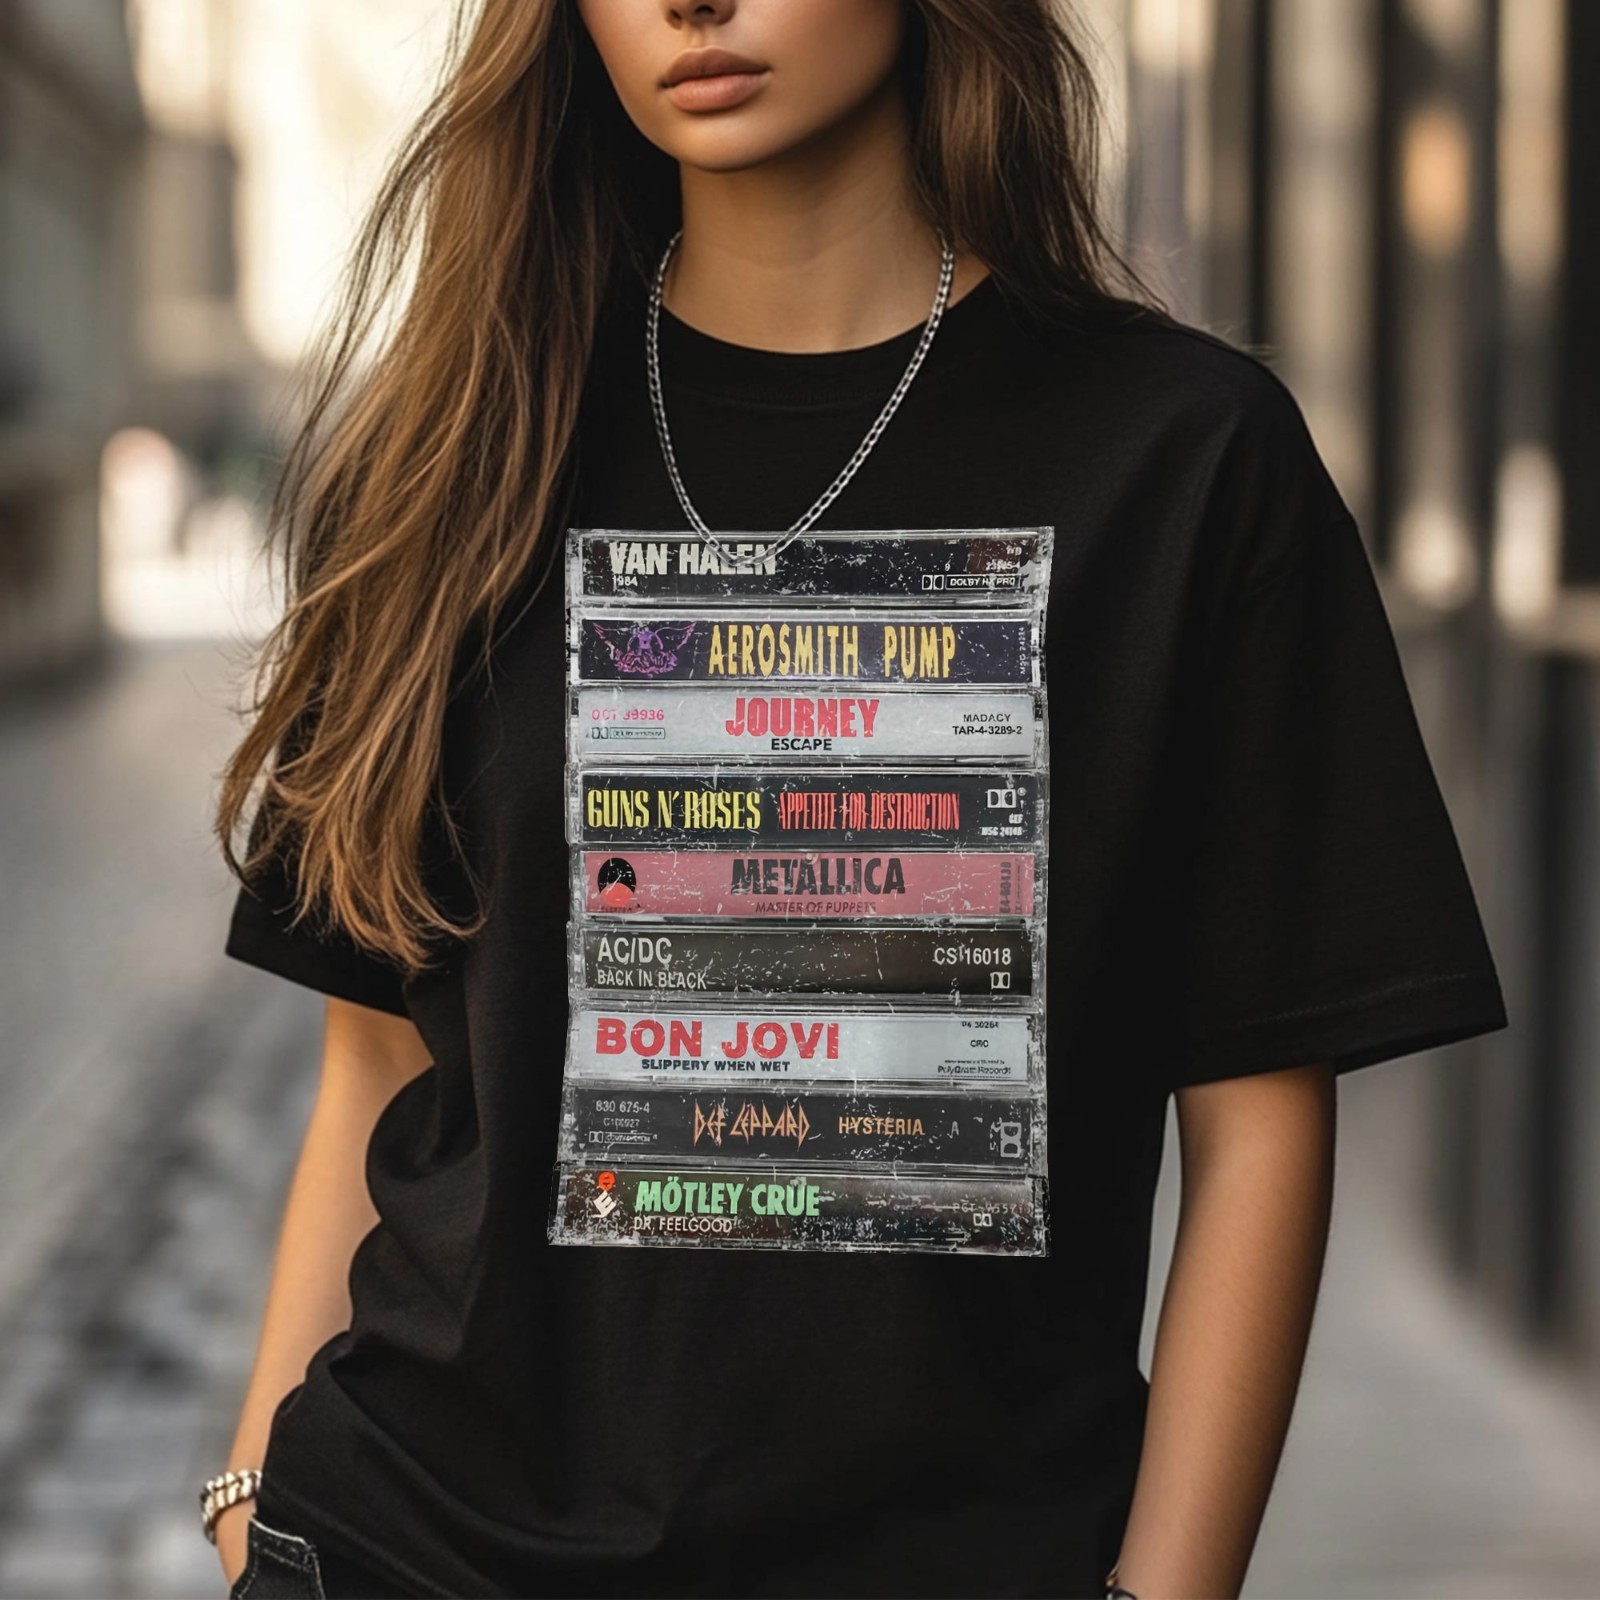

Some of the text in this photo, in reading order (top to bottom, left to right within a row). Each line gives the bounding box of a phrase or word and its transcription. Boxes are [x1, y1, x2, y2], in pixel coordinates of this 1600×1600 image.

[609, 542, 777, 575] VAN HALEN
[612, 574, 638, 587] 1984
[950, 578, 980, 587] DOLBY
[996, 577, 1016, 587] PRO
[708, 623, 956, 680] AEROSMITH PUMP
[591, 709, 617, 721] OCT
[725, 697, 880, 738] JOURNEY
[963, 713, 1011, 723] MADACY
[952, 725, 1023, 735] TAR-4-3289-2
[771, 738, 833, 752] ESCAPE
[587, 789, 650, 829] GUNS
[683, 791, 761, 830] ROSES
[778, 792, 960, 831] APPETITE FOR DESTRUCTION
[730, 858, 906, 896] METALLICA
[755, 901, 877, 914] MASTER OF PUPPETS
[598, 937, 673, 965] AC/DC
[934, 947, 1011, 965] CS 16018
[597, 968, 707, 989] BACK IN BLACK
[596, 1018, 839, 1059] BON JOVI
[641, 1059, 790, 1072] SLIPPERY WHEN WET
[596, 1100, 650, 1114] 830 675-4
[729, 1102, 810, 1152] LEPPARD
[838, 1116, 925, 1136] HYSTERIA
[634, 1176, 744, 1215] MÖTLEY
[659, 1218, 732, 1233] FEELGOOD
